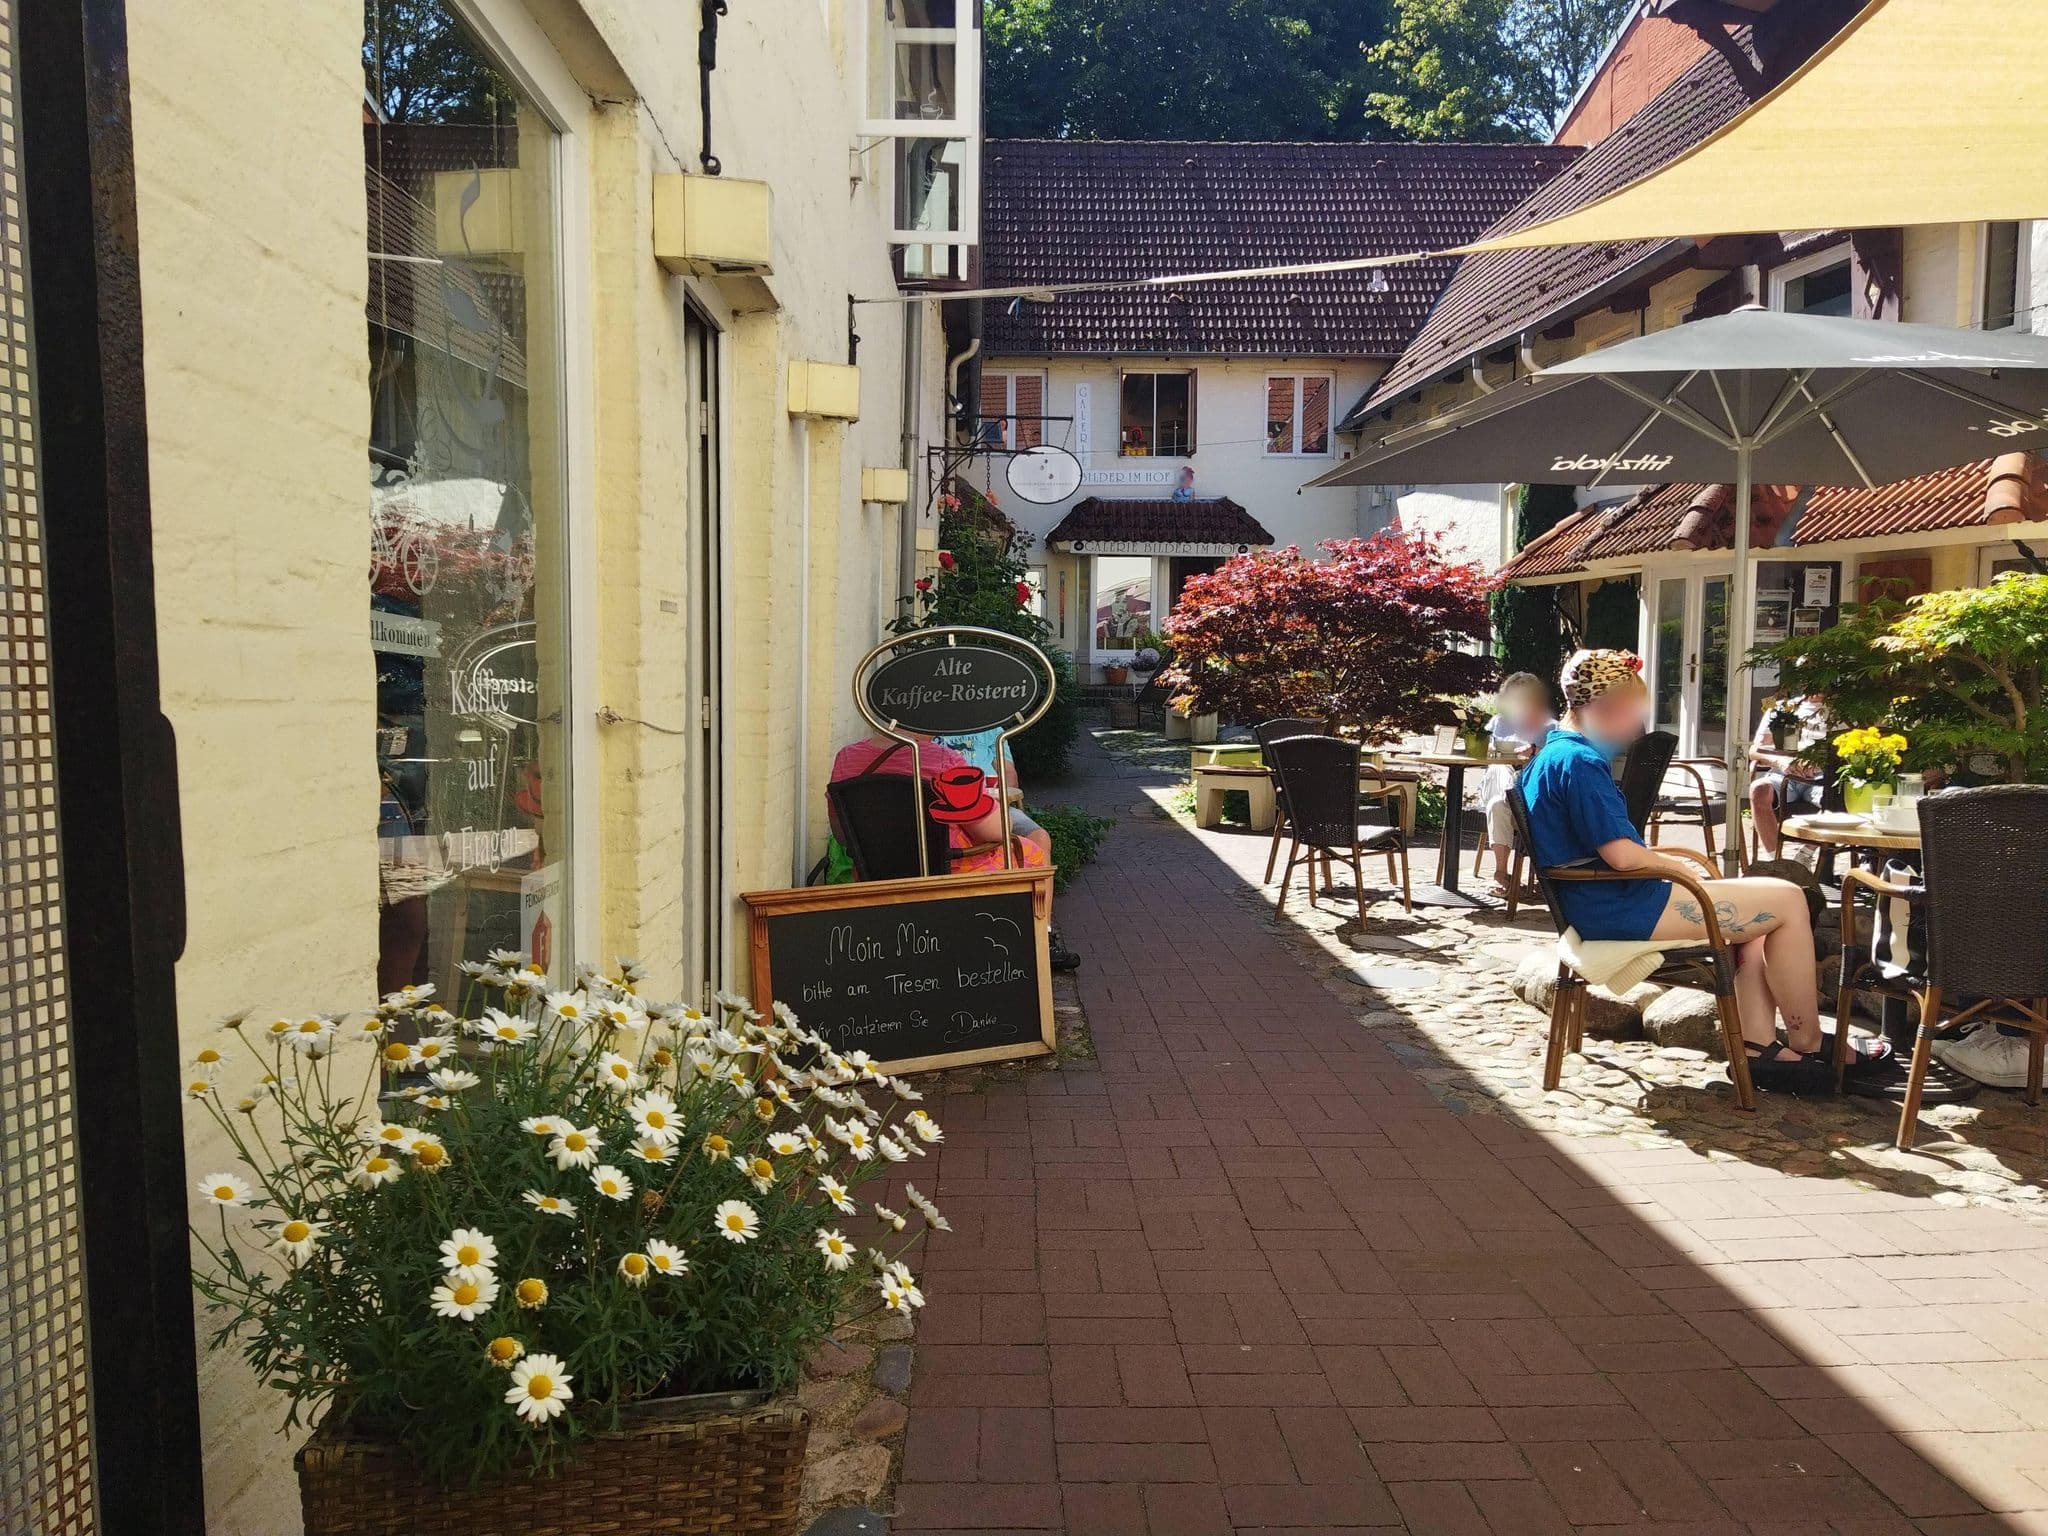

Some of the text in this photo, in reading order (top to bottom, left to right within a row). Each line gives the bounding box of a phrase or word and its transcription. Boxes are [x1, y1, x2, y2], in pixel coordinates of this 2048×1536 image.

[1078, 386, 1088, 469] GALERIE
[1128, 472, 1141, 483] IM
[1145, 472, 1170, 483] HOF
[1084, 541, 1138, 552] GALERIE
[1144, 542, 1191, 553] BILDER
[1196, 543, 1209, 554] IM
[370, 619, 430, 648] llkommen
[933, 657, 973, 678] Alte
[449, 668, 510, 716] Kaffee
[881, 679, 1028, 710] Kaffee-Rösterei
[467, 744, 499, 792] auf
[460, 825, 518, 874] Etagen
[825, 922, 941, 966] Moin Moin
[802, 961, 1029, 1002] bitte am Tresen bestellen
[839, 1015, 903, 1048] platzieren
[910, 1009, 929, 1029] Sie
[950, 1010, 998, 1034] Danke
